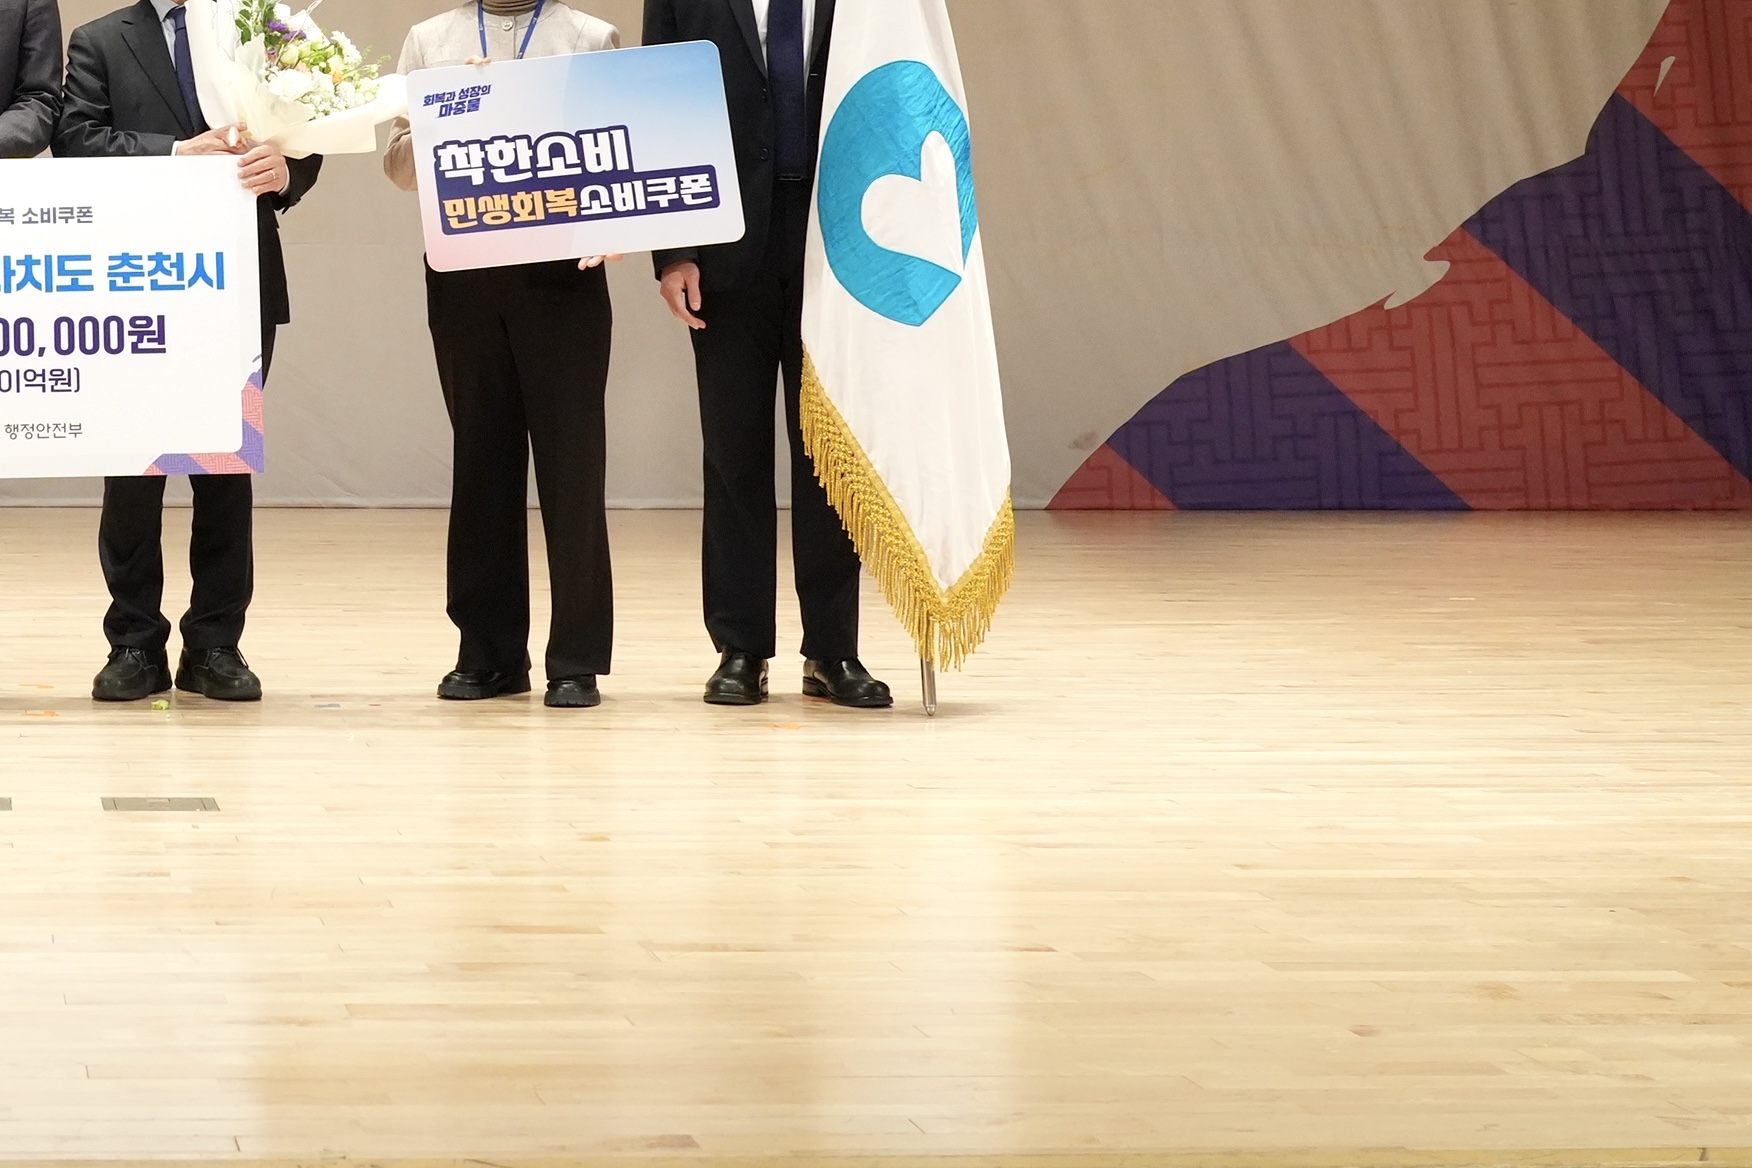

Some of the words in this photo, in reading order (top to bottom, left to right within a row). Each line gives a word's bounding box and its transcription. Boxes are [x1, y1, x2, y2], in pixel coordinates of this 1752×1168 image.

[423, 91, 456, 107] 회복과
[458, 84, 492, 100] 성장의
[437, 97, 481, 118] 마중물
[437, 129, 631, 186] 착한소비
[21, 206, 94, 226] 소비쿠폰
[106, 251, 226, 292] 춘천시
[4, 422, 84, 441] 행정안전부
